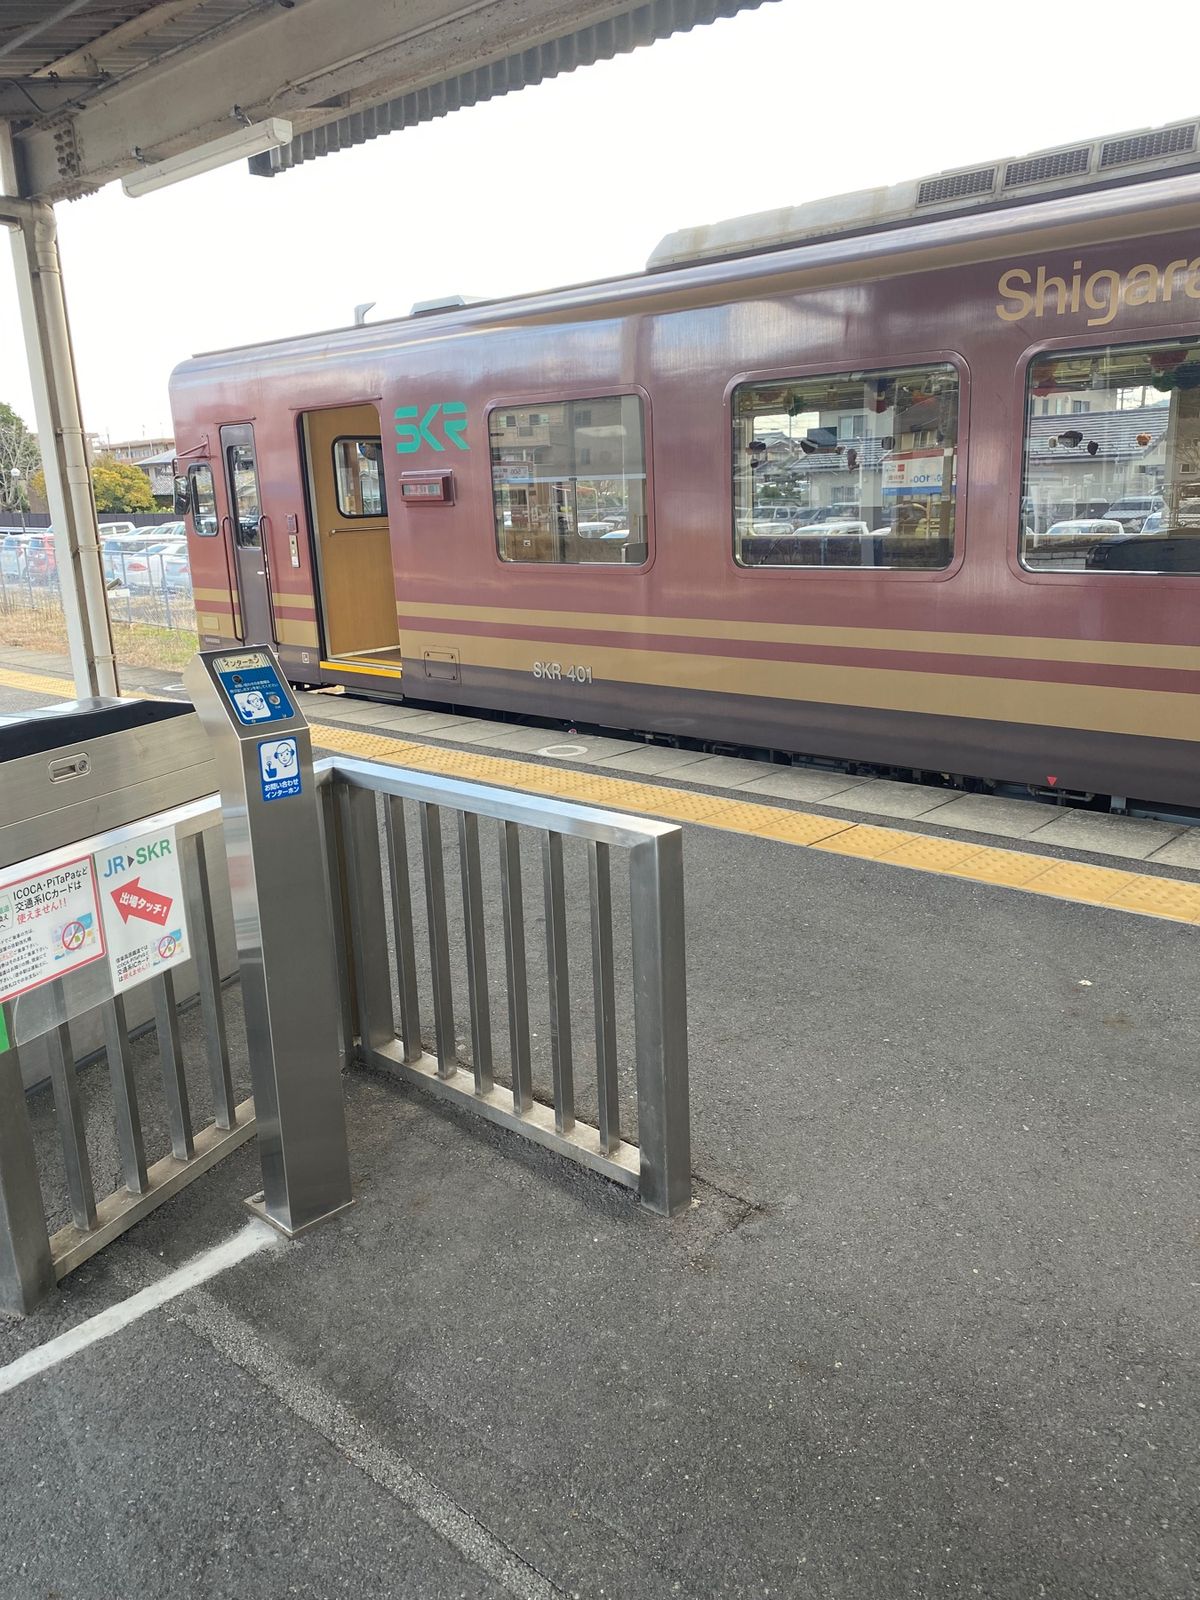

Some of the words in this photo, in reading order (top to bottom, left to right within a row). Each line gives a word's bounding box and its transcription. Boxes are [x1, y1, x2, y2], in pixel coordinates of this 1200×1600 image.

[394, 401, 471, 454] SKR
[533, 661, 561, 680] SKR
[566, 665, 592, 684] 401
[264, 778, 299, 791] お問い合わせ
[265, 786, 300, 799] インターホン
[104, 855, 126, 878] JR
[136, 839, 172, 865] SKR
[15, 880, 82, 914] 交通系ICカードは
